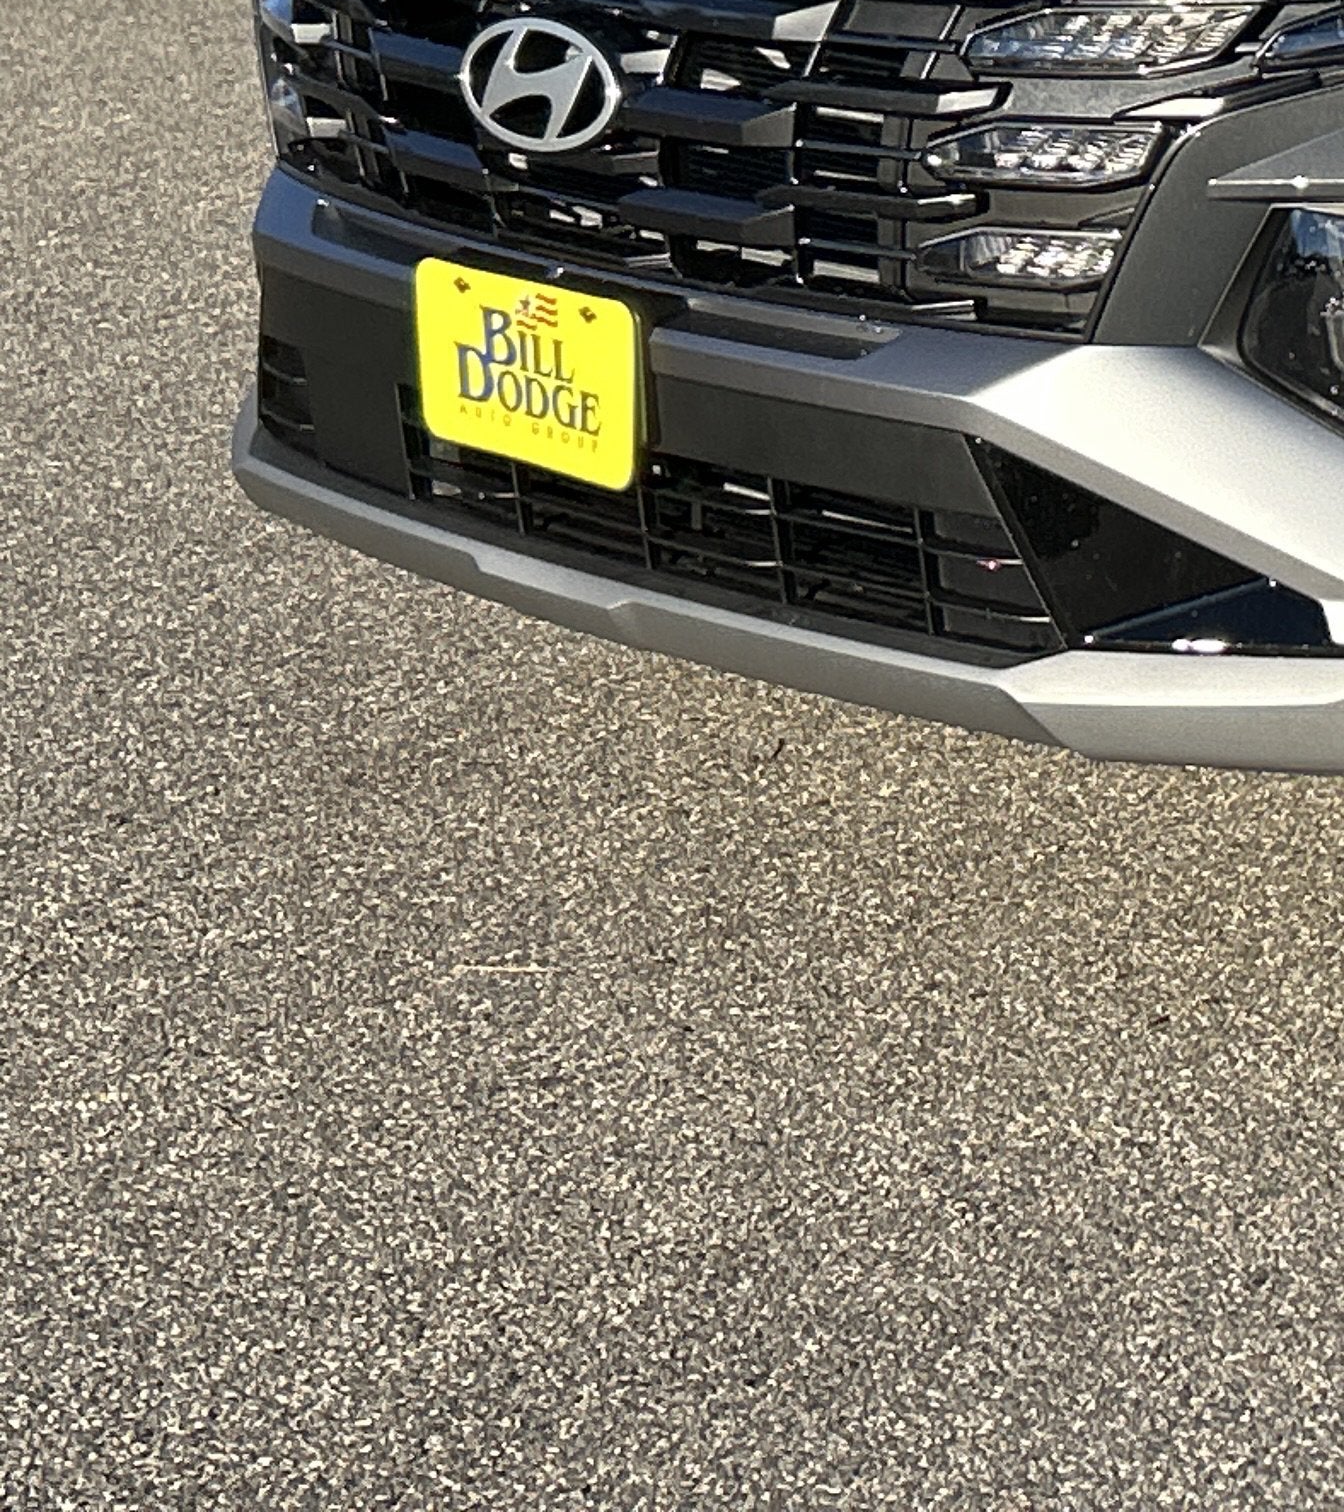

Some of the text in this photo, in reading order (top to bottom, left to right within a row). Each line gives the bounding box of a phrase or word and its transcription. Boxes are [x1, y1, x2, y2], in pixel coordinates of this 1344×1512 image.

[479, 304, 575, 384] BILL
[454, 341, 602, 436] DODGE
[459, 404, 599, 454] AUTO GROUP
